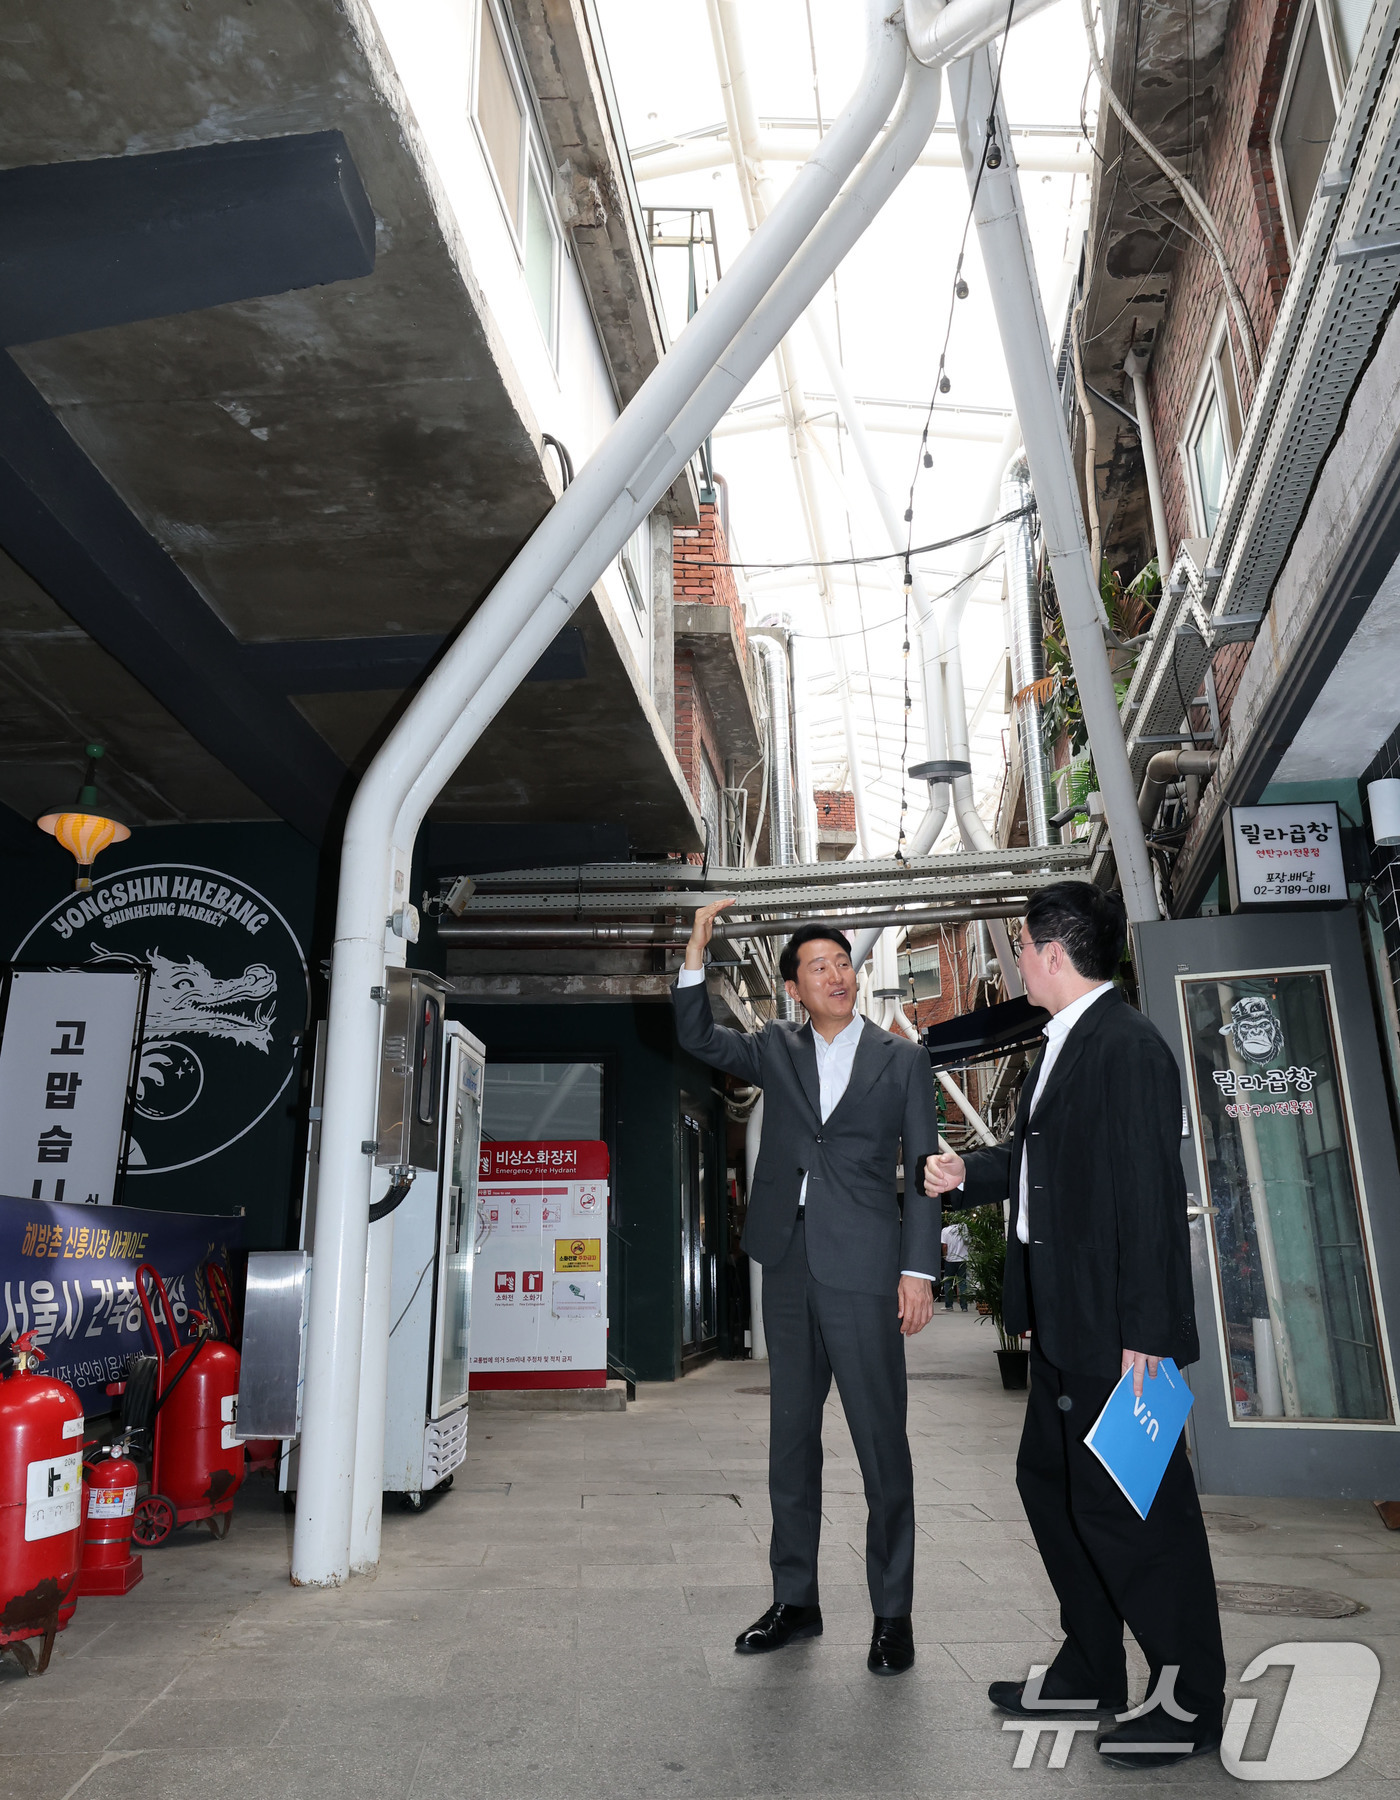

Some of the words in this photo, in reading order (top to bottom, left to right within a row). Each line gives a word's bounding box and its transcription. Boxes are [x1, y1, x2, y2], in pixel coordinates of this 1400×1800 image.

[1240, 822, 1333, 845] 릴라곱창
[1256, 847, 1320, 858] 연탄구이전문점
[1266, 871, 1315, 883] 포장.배달
[1253, 884, 1331, 895] 02-3789-0181
[51, 876, 168, 939] YONGSHIN
[170, 876, 269, 935] HAEBANG
[102, 902, 176, 928] SHINHEUNG
[177, 903, 228, 928] MARKET
[1212, 1066, 1317, 1095] 릴라곱창
[1225, 1100, 1313, 1117] 연탄구이전문점
[496, 1149, 577, 1165] 비상소화장치
[495, 1167, 533, 1175] Emergency
[549, 1167, 577, 1175] Hydrant
[21, 1221, 63, 1258] 해방촌
[63, 1226, 110, 1259] 신흥시장
[109, 1231, 149, 1259] 아케이드
[0, 1279, 84, 1347] 서울시
[73, 1360, 105, 1387] 상인회
